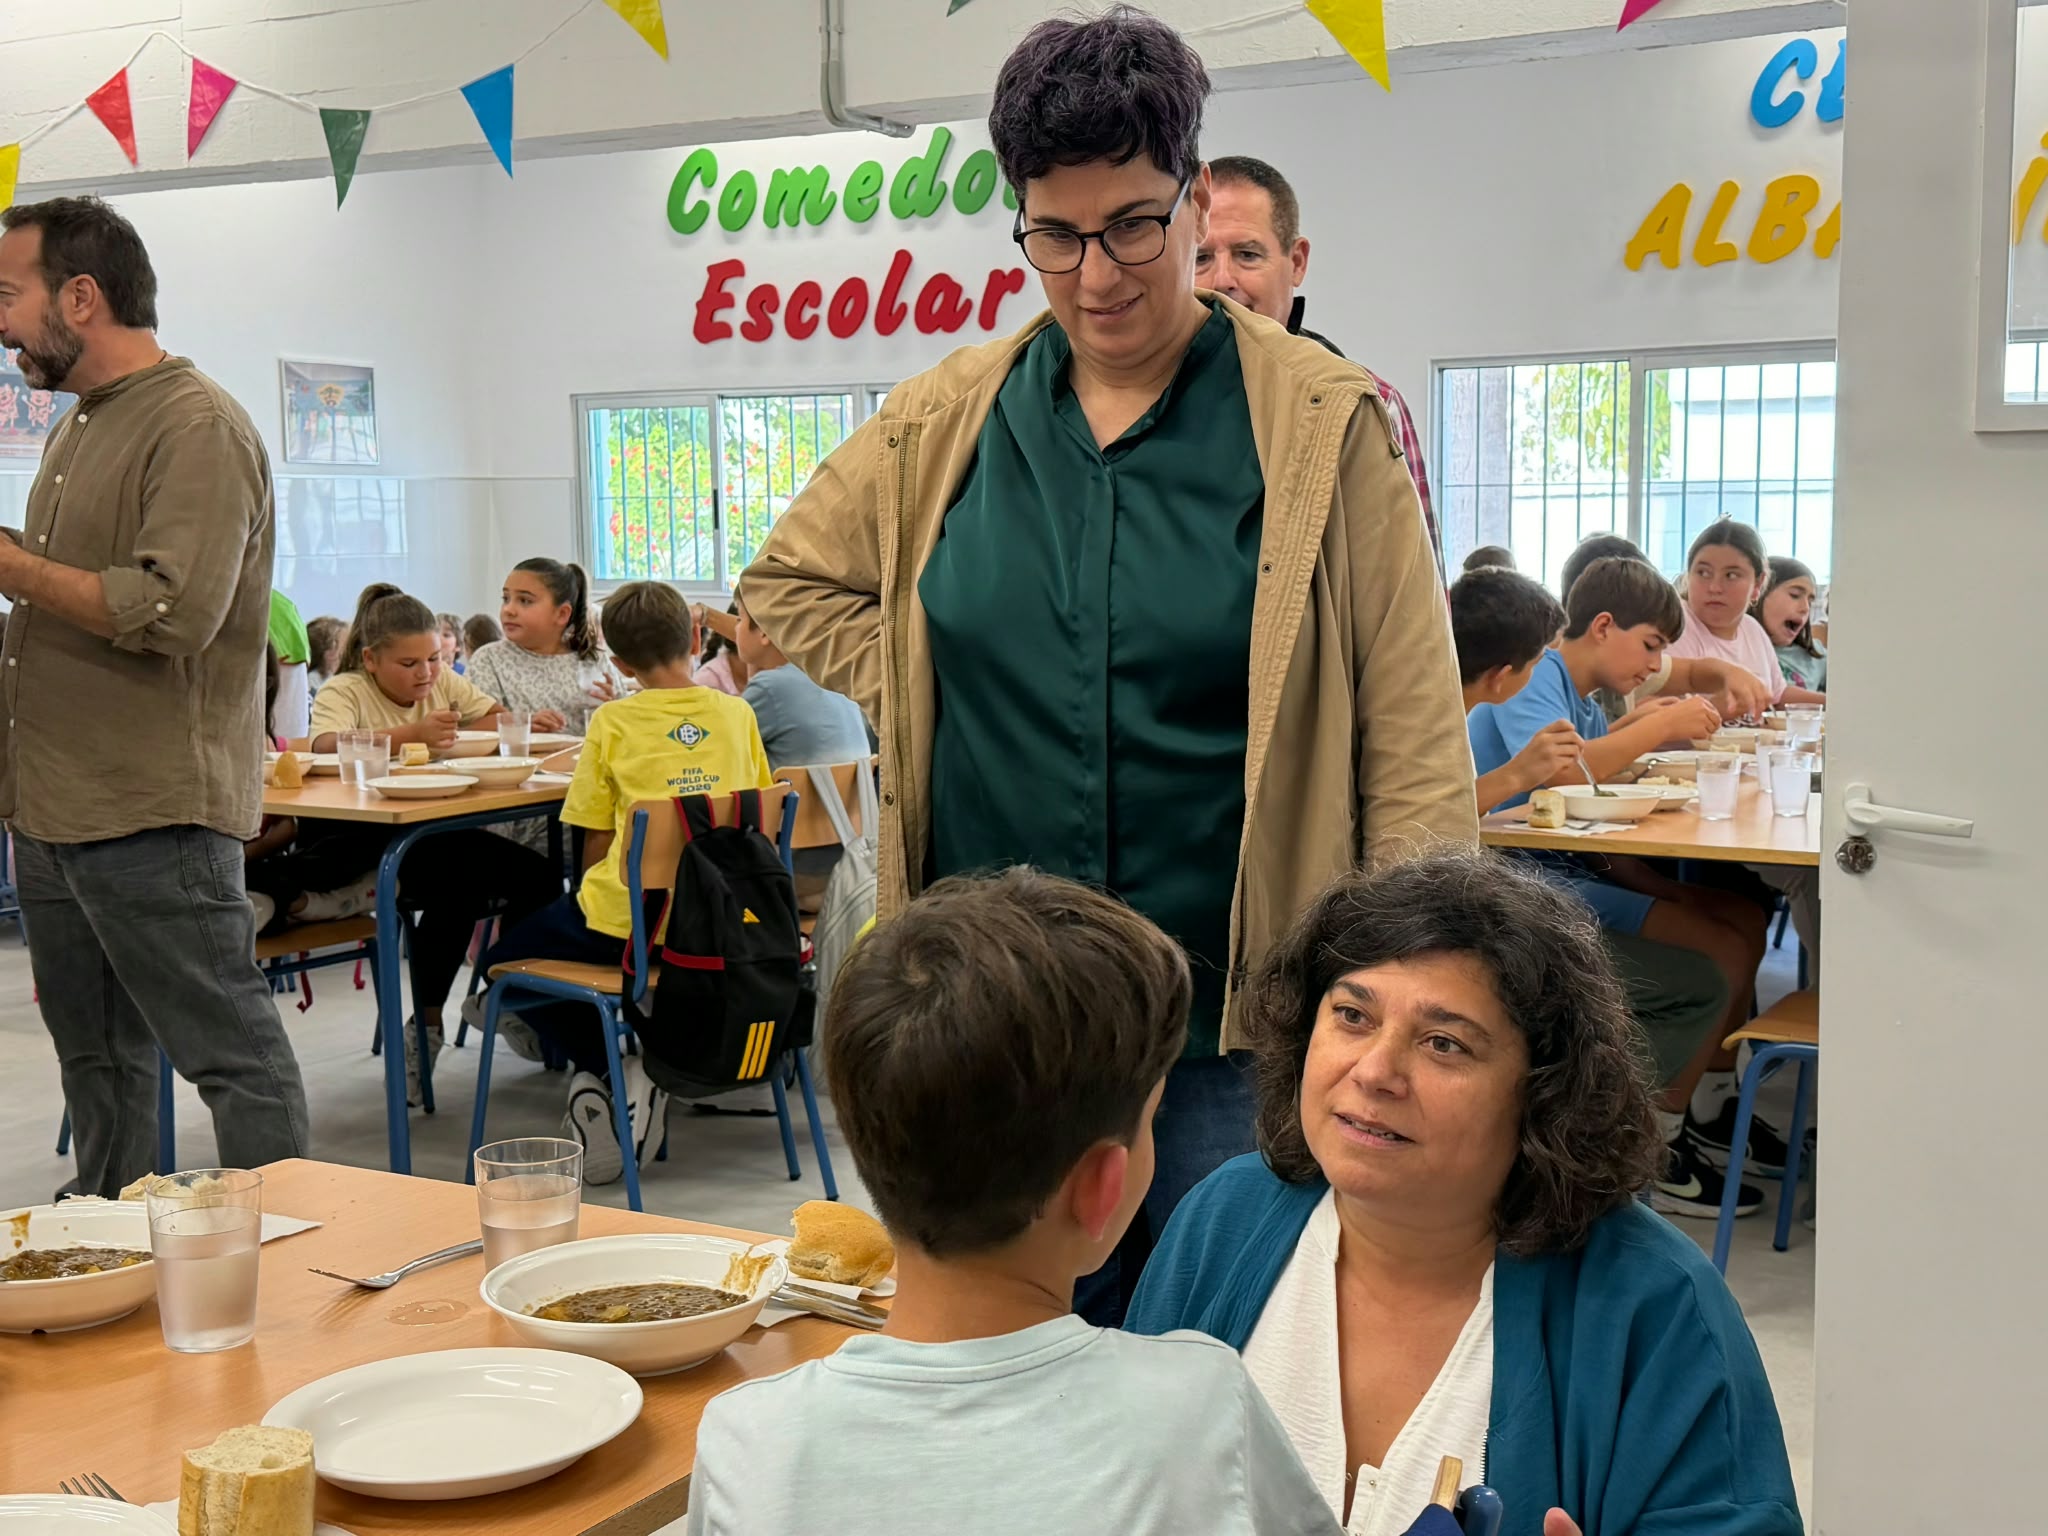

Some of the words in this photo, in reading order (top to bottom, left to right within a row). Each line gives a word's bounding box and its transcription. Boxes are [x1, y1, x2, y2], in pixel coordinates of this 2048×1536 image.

[667, 127, 1018, 235] Comedo
[693, 249, 1026, 344] Escolar
[683, 767, 703, 775] FIFA
[667, 776, 701, 786] WORLD
[703, 775, 720, 783] CUP
[679, 784, 711, 793] 2026
